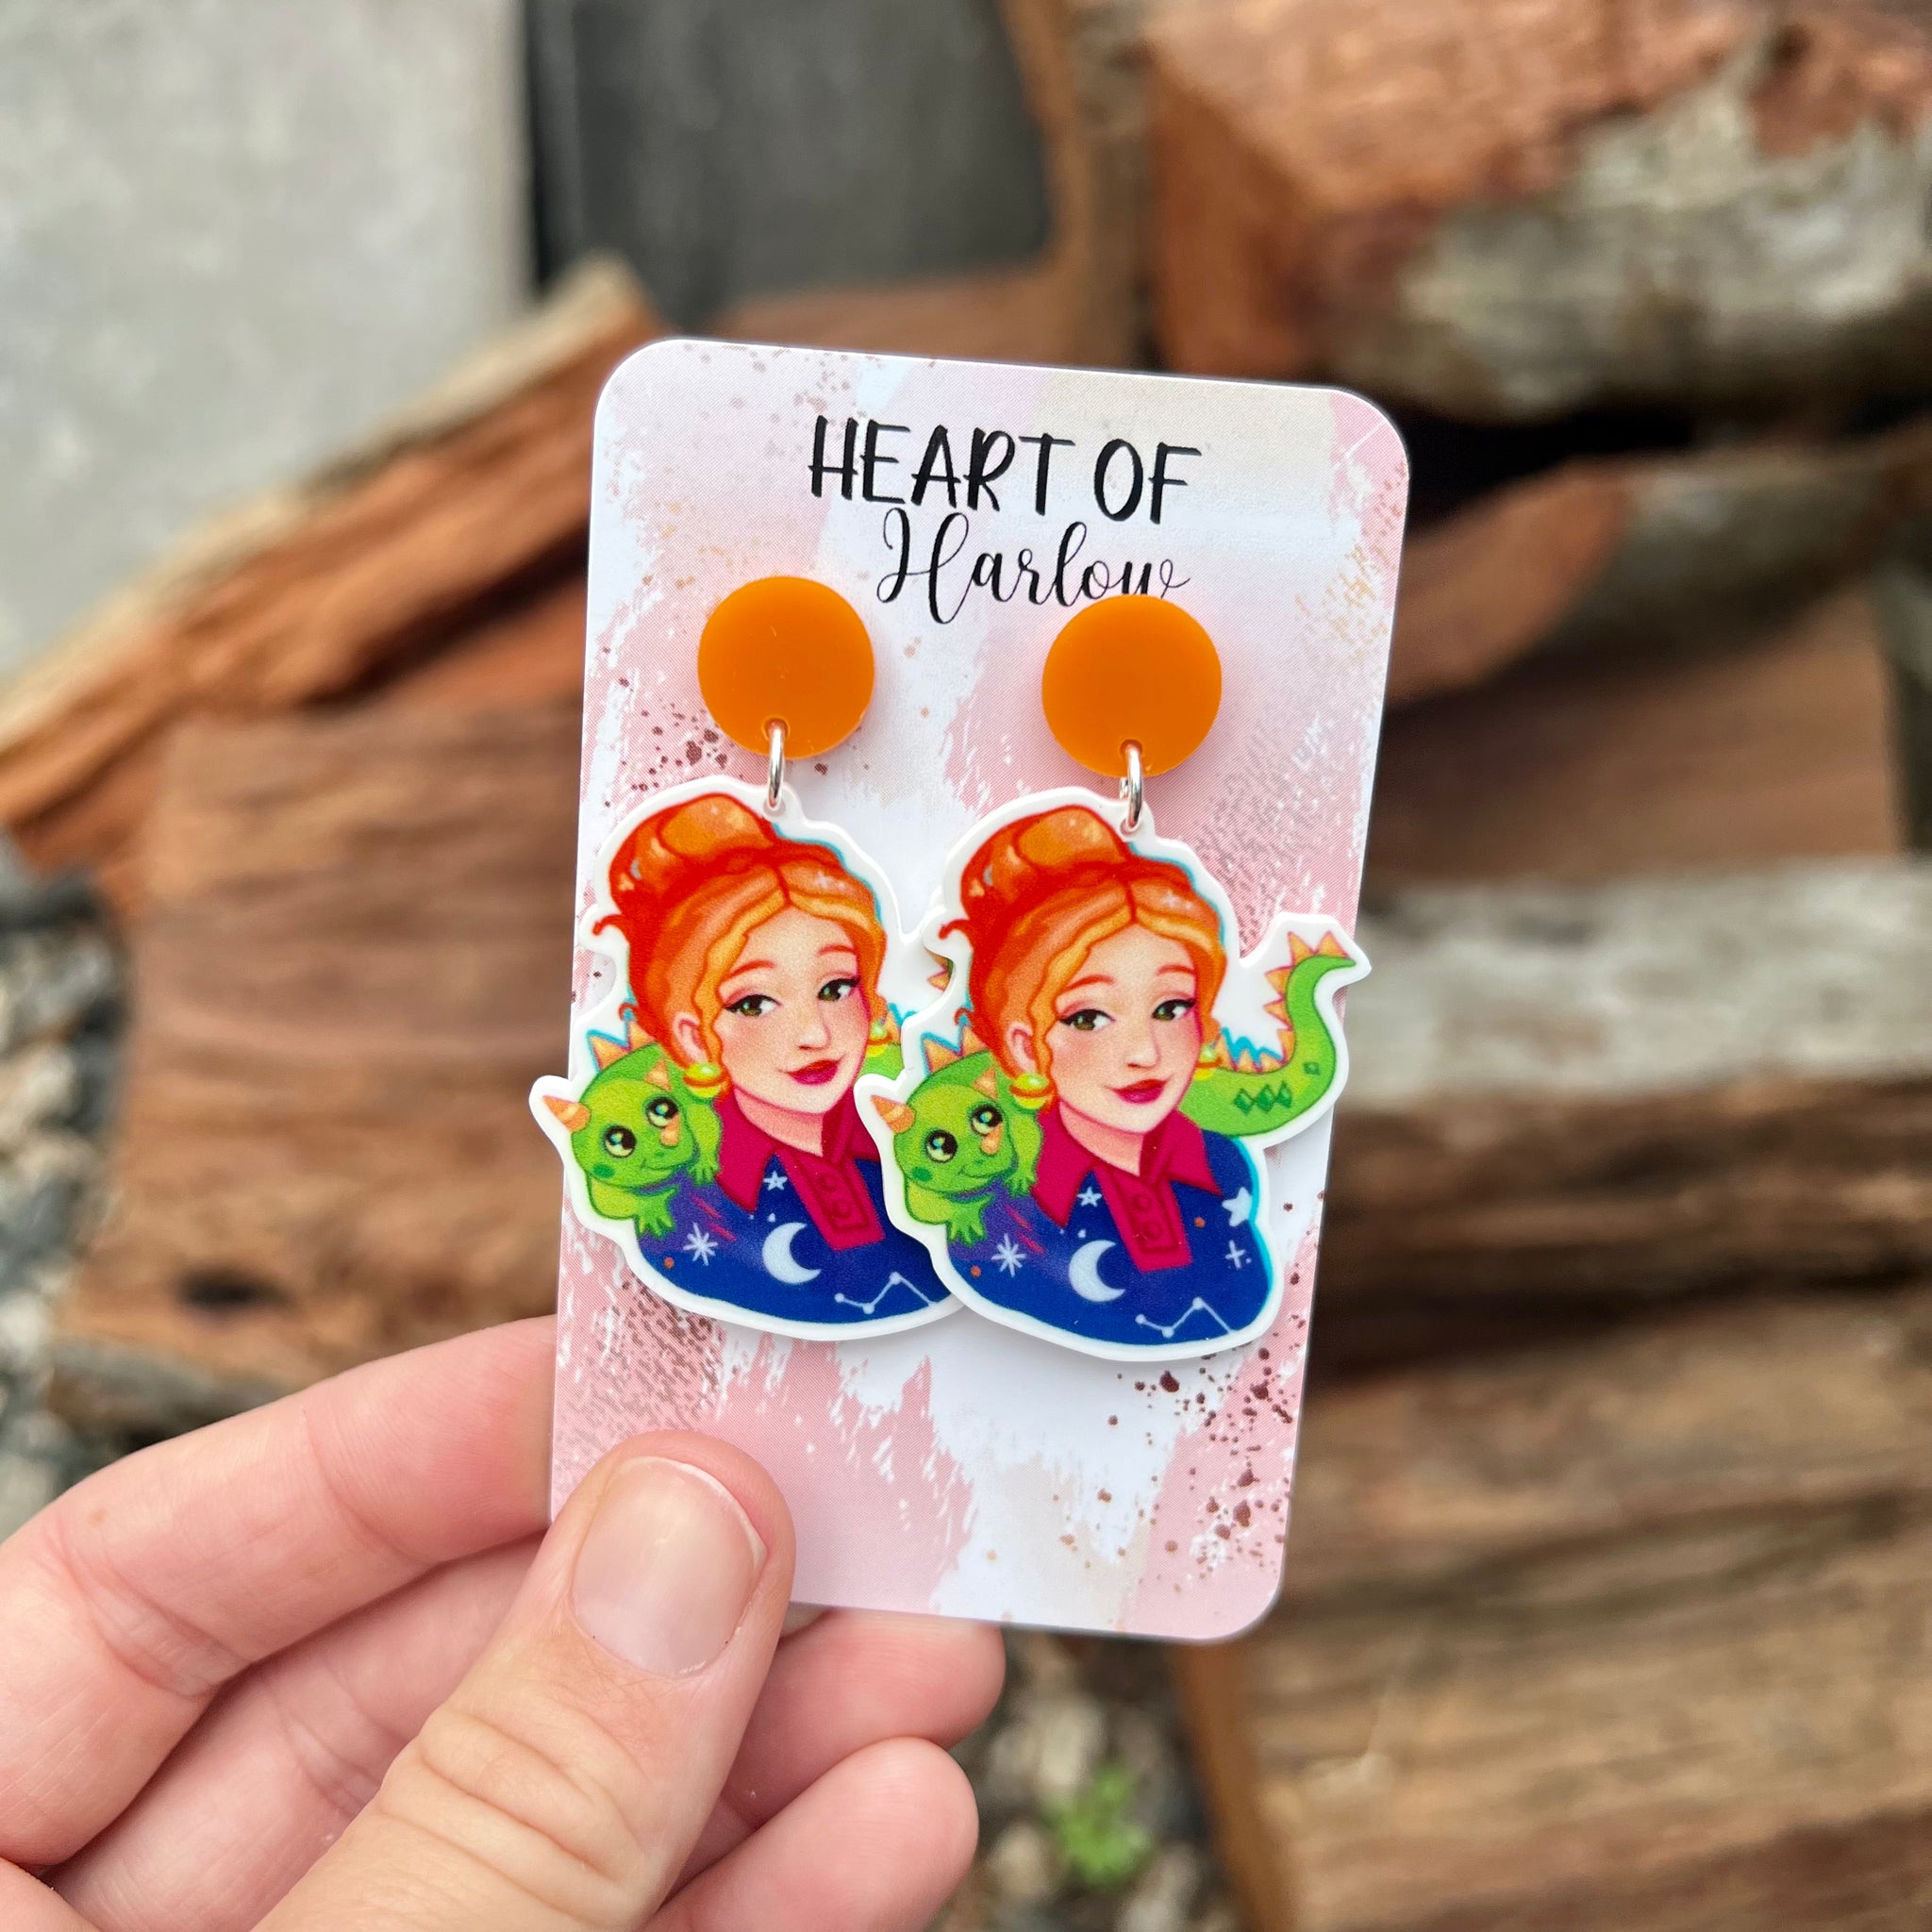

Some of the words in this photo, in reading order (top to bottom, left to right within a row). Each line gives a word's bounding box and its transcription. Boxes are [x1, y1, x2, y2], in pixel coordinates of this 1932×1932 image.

[808, 415, 1075, 516] HEART
[1093, 438, 1202, 525] OF
[876, 507, 1191, 625] Harlow
